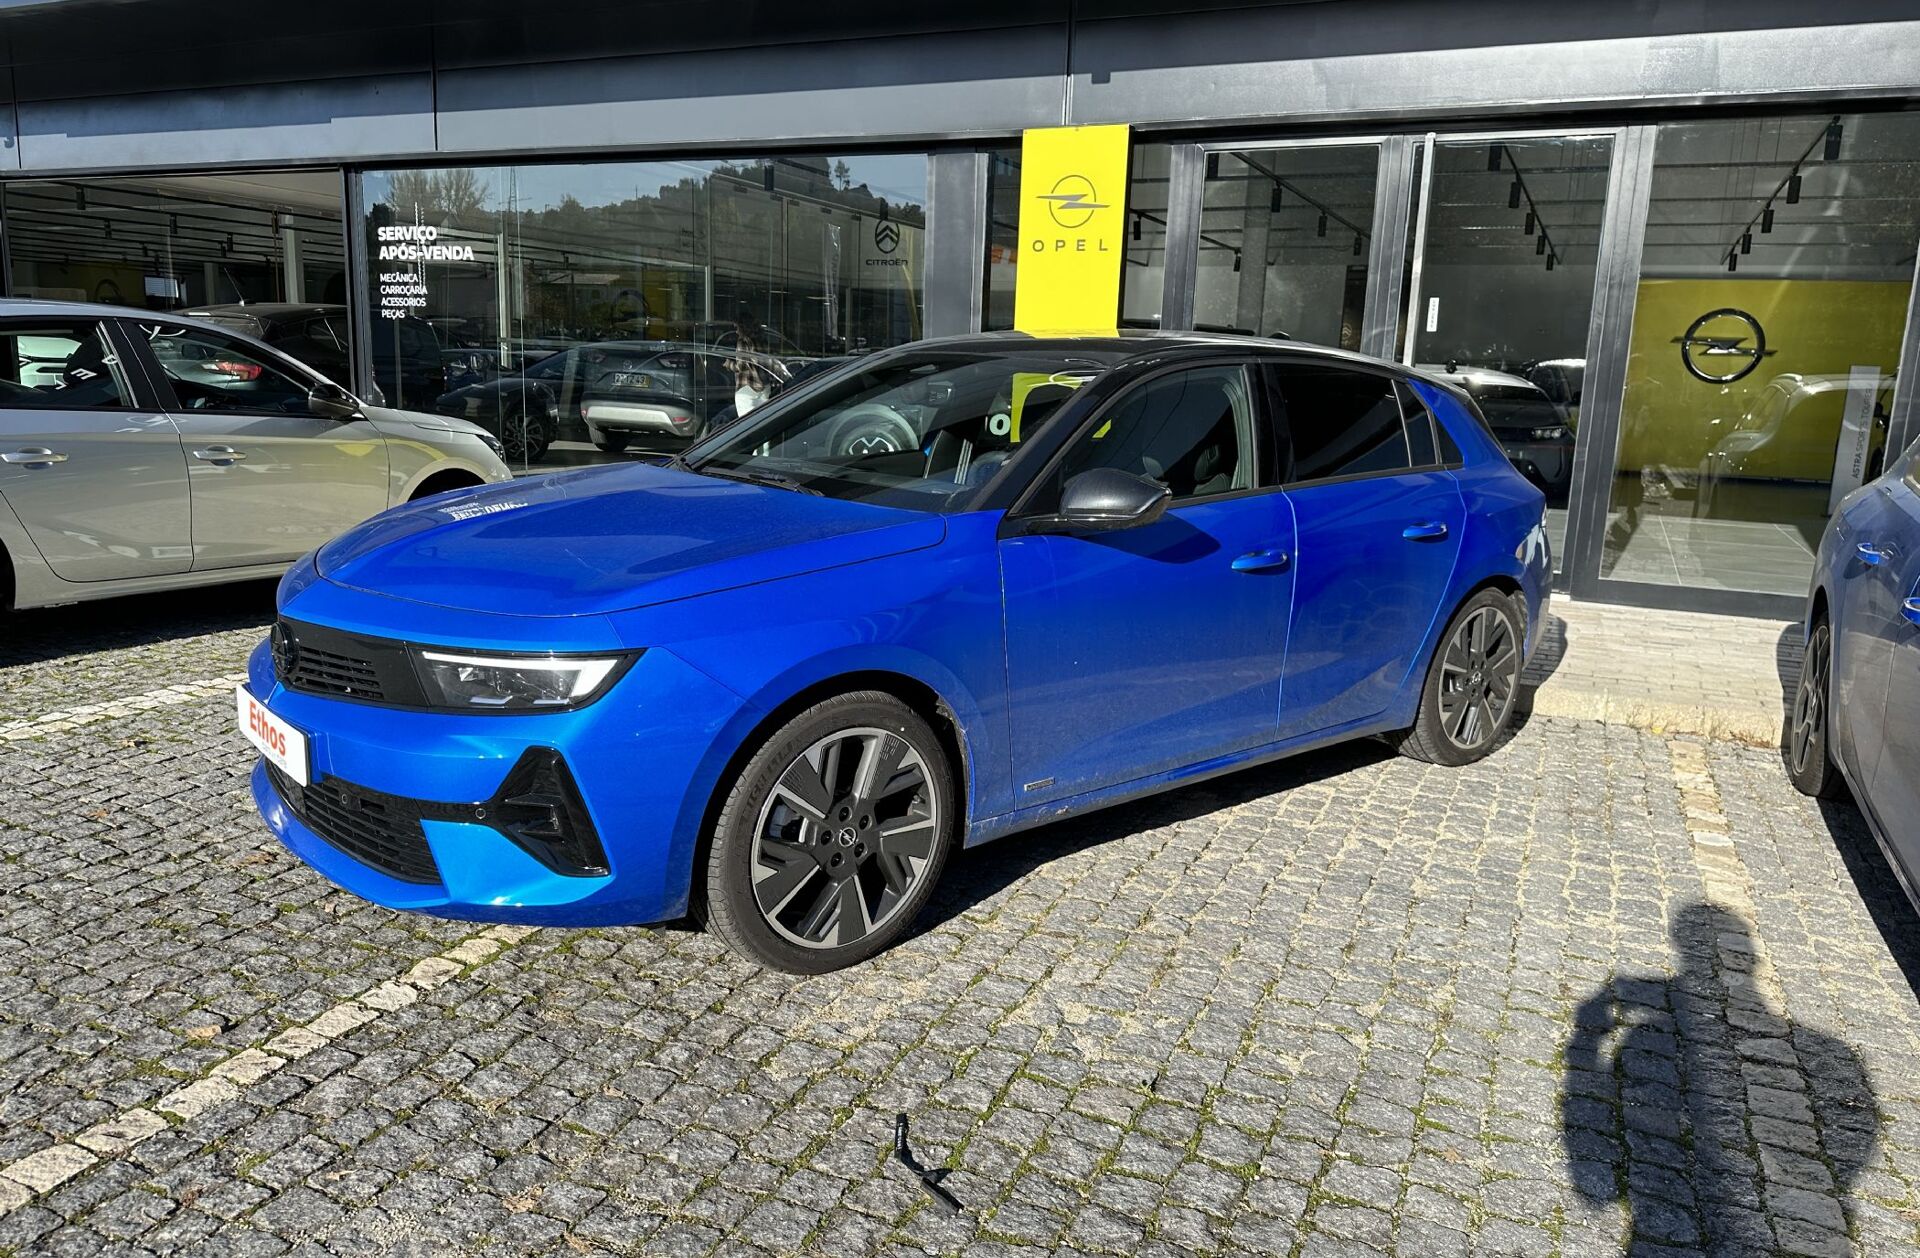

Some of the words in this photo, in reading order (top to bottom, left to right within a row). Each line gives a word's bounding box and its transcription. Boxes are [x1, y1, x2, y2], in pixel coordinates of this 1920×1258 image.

[377, 225, 437, 244] SERVIÇO
[379, 242, 475, 260] APÓS-VENDA
[1032, 239, 1109, 252] OPEL
[380, 272, 418, 283] MECÂNICA
[380, 285, 428, 296] CARROÇARIA
[381, 308, 405, 320] PEÇAS
[1852, 452, 1863, 479] ASTRA
[249, 700, 286, 757] Ethos
